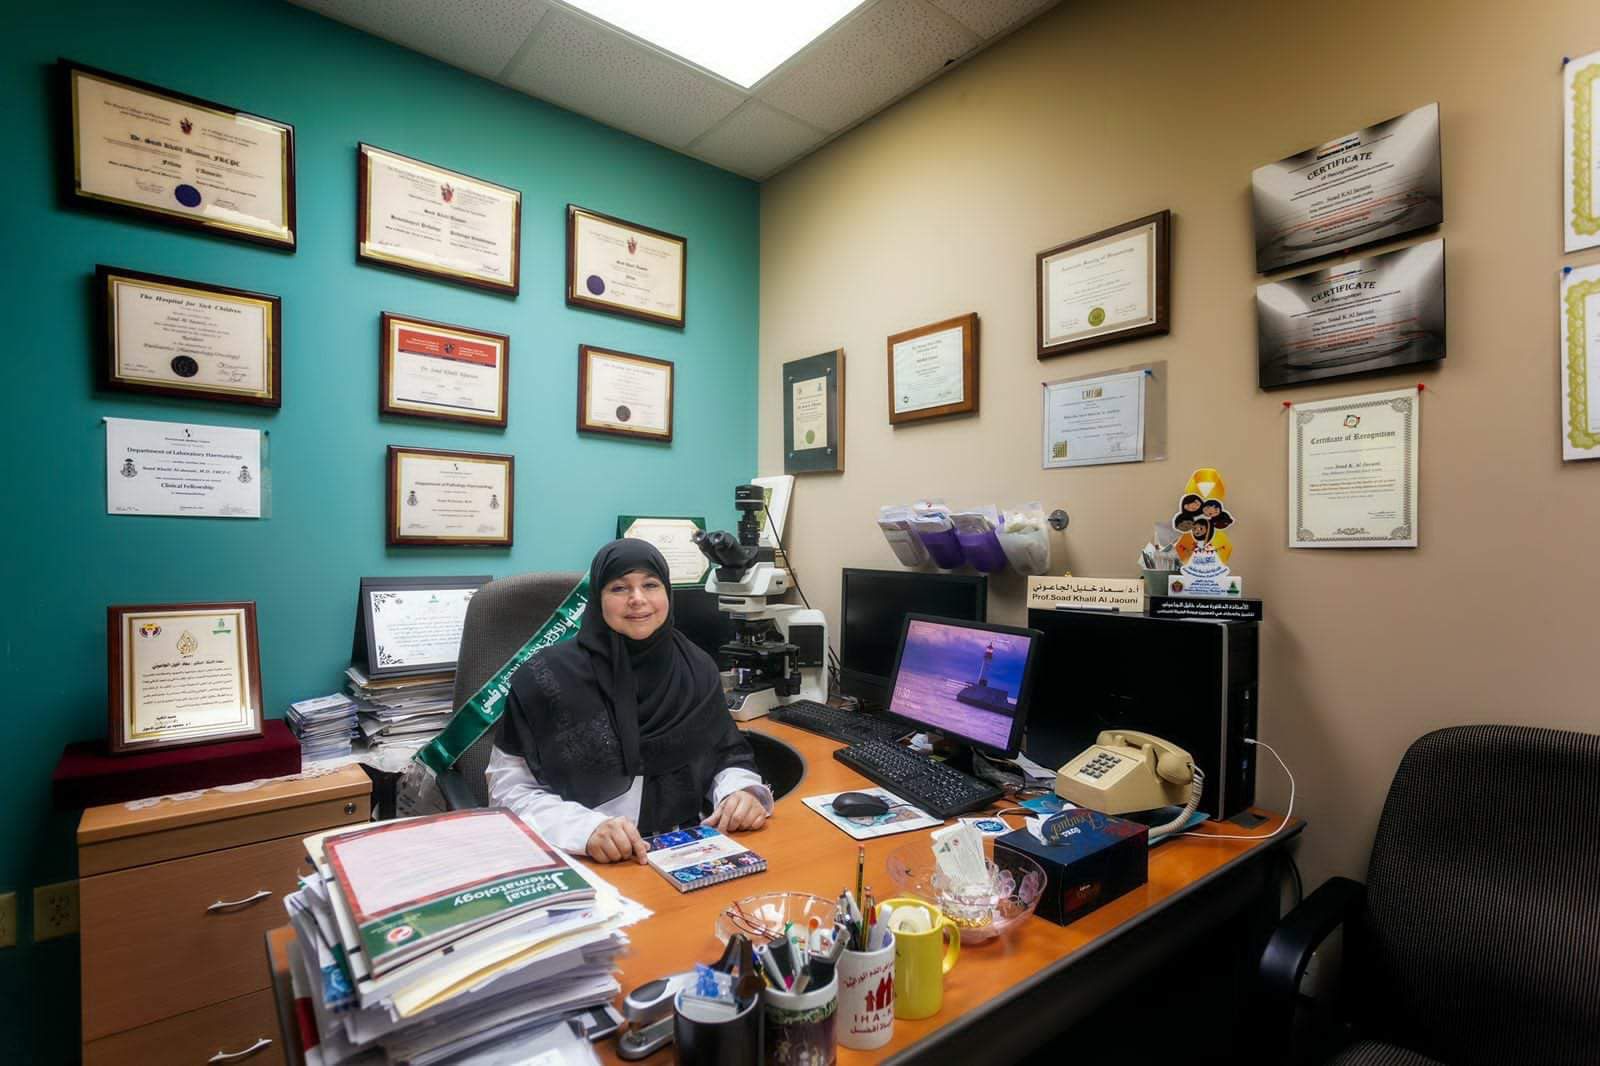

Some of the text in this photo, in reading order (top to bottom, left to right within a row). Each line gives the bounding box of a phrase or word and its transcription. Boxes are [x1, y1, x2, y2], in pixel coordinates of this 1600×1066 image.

[1306, 151, 1373, 181] CERTIFICATE
[1311, 281, 1376, 303] CERTIFICATE
[140, 293, 153, 301] The
[156, 295, 184, 306] Hospital
[185, 299, 195, 307] for
[199, 301, 212, 310] Sick
[214, 305, 242, 314] Children
[1310, 435, 1343, 446] Certificate
[1353, 430, 1396, 441] Recognition
[127, 447, 165, 455] Department
[173, 450, 205, 458] Laboratory
[183, 483, 214, 491] Fellowship
[1073, 595, 1097, 603] Khalil
[1109, 596, 1138, 604] Jaouni
[453, 873, 550, 907] Hematology
[506, 872, 569, 904] Journal
